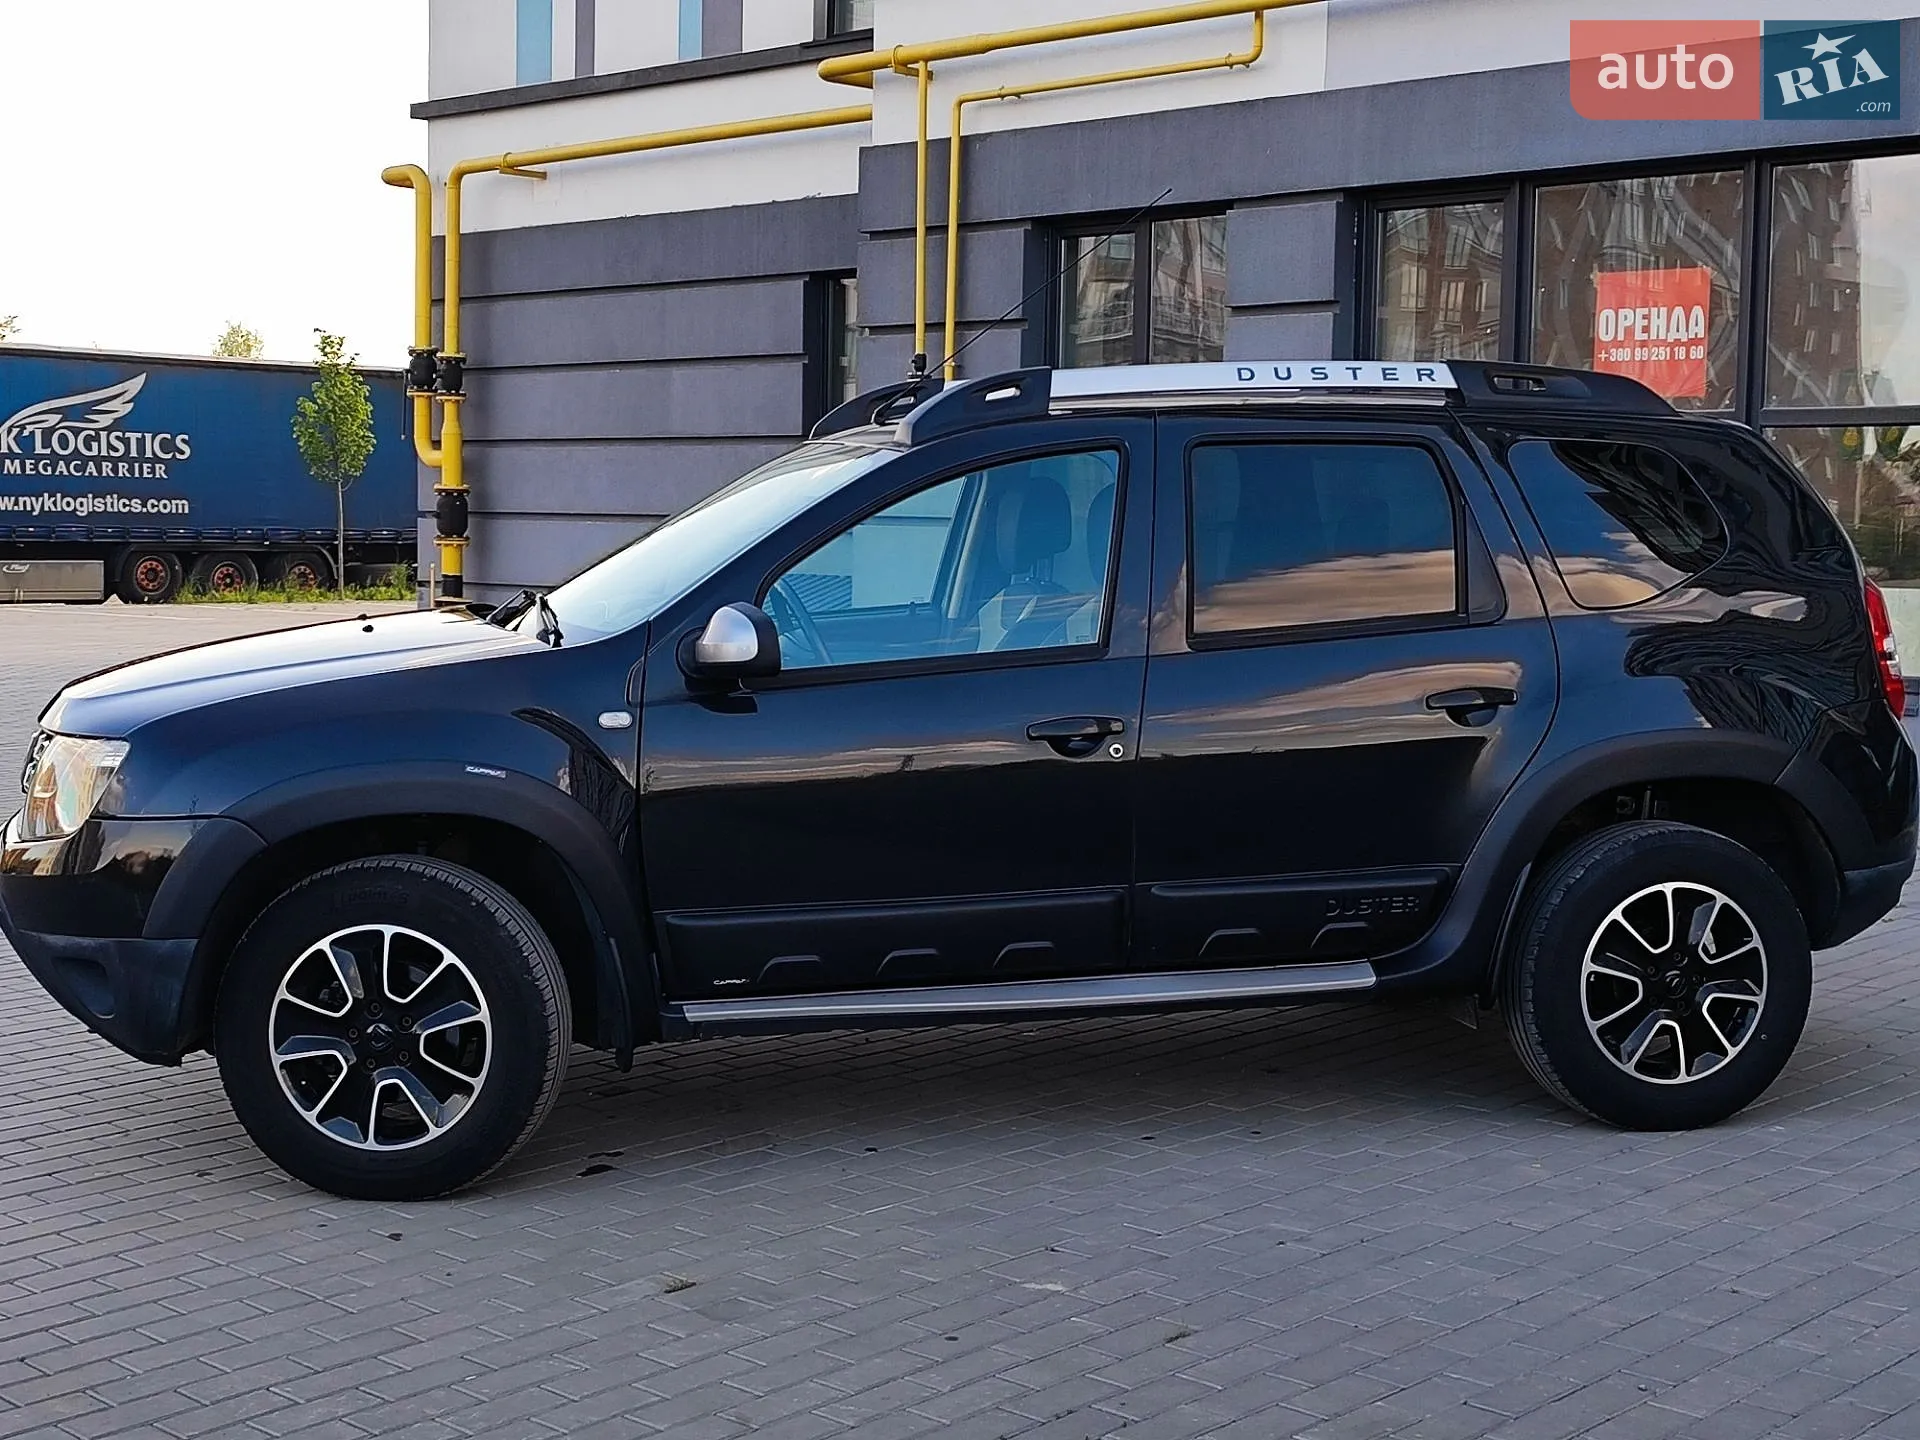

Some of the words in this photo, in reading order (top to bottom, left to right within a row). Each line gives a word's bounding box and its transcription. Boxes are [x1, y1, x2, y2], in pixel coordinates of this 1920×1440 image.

[1598, 305, 1705, 342] ОРЕНДА
[1598, 347, 1631, 362] +380
[1634, 347, 1649, 361] 99
[1651, 346, 1671, 361] 251
[1690, 345, 1704, 360] 60
[1237, 366, 1437, 383] DUSTER
[3, 459, 168, 479] MEGACARRIER
